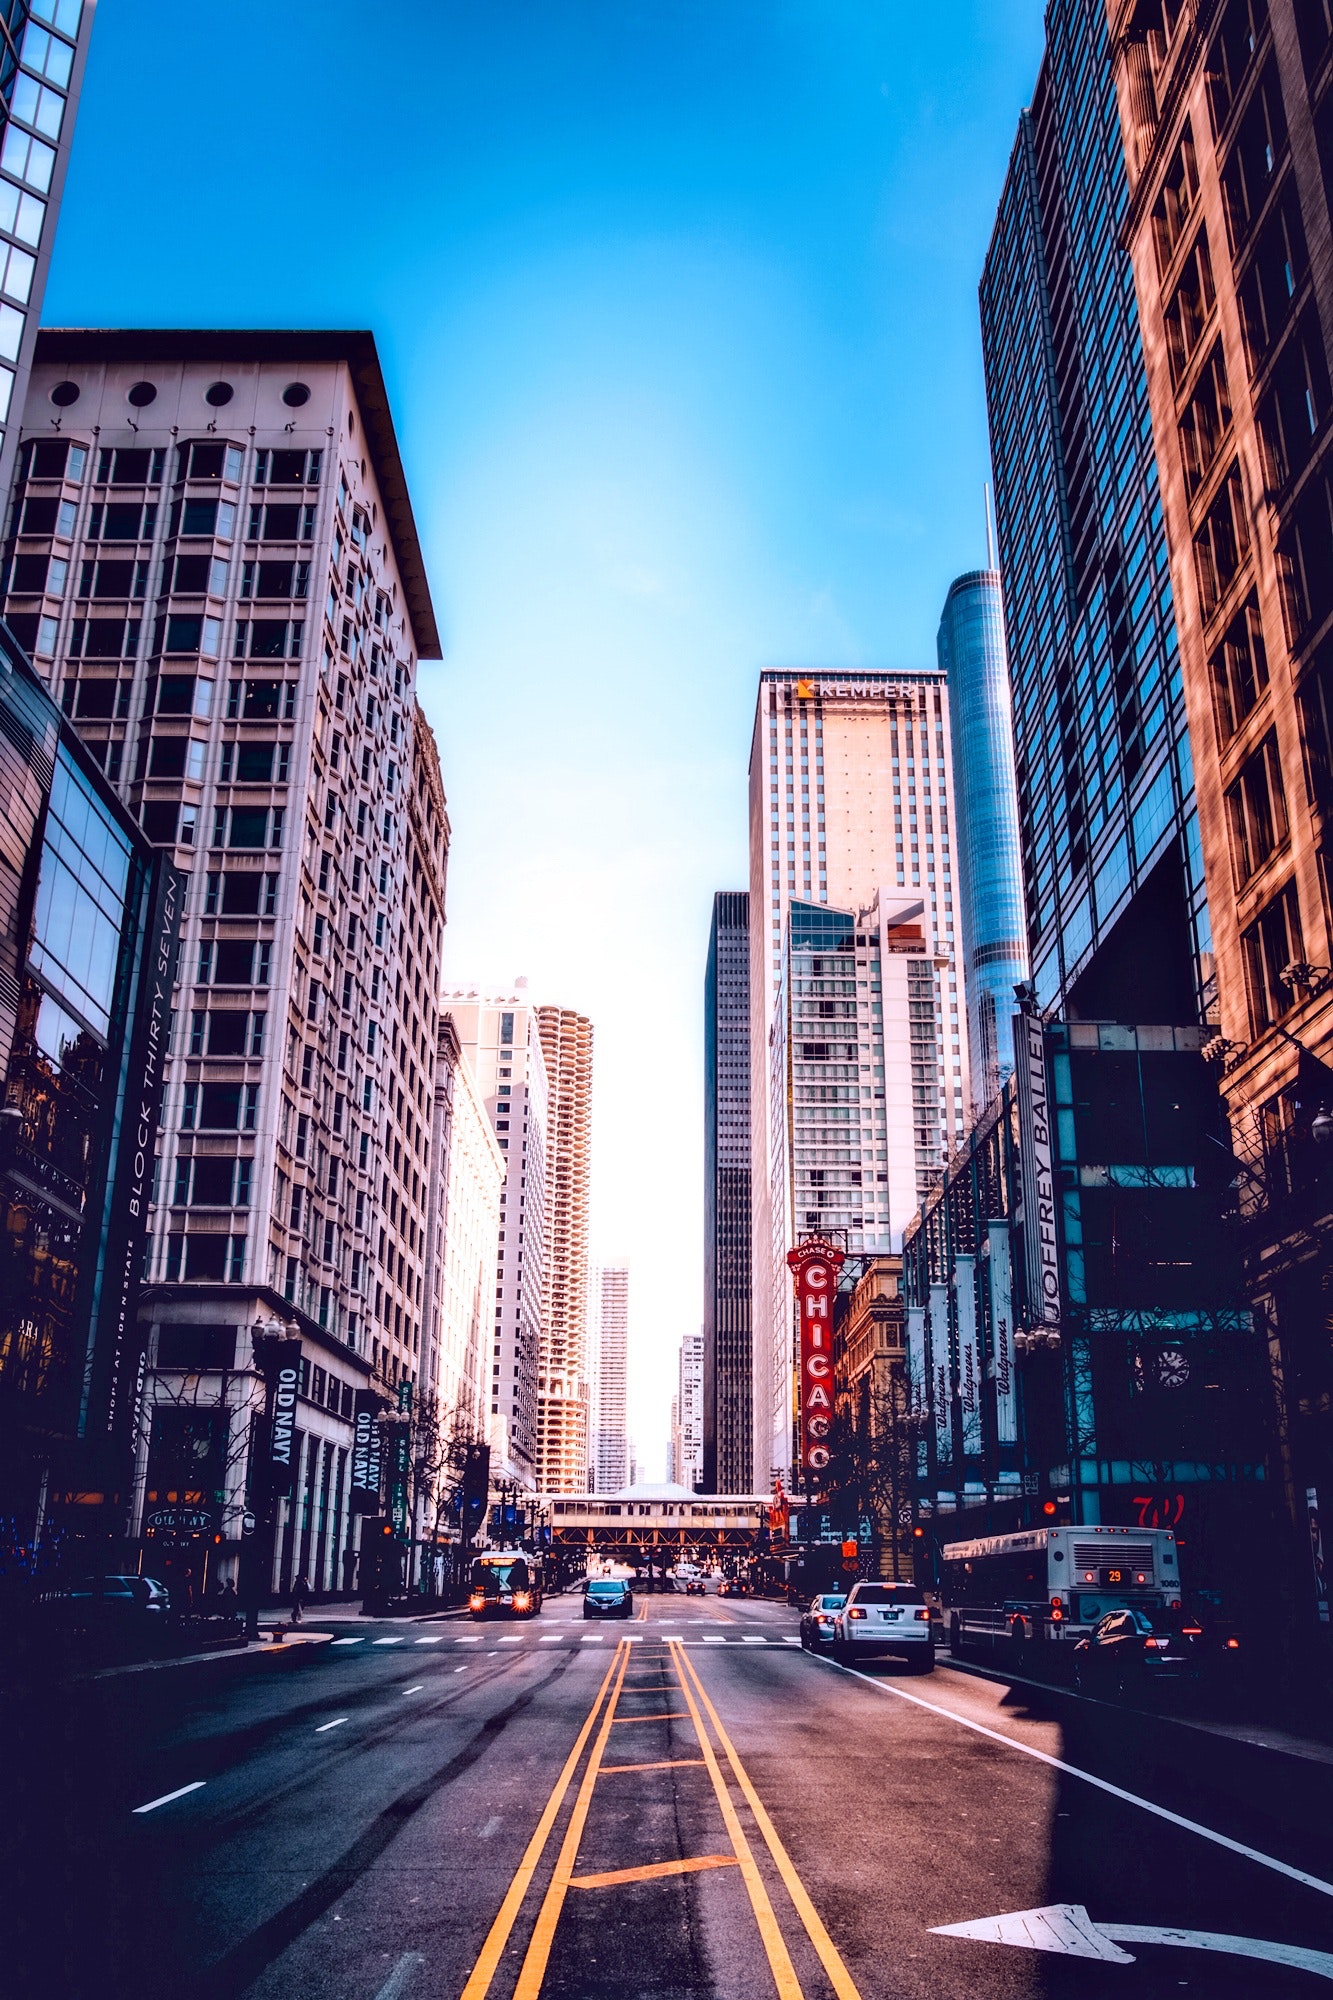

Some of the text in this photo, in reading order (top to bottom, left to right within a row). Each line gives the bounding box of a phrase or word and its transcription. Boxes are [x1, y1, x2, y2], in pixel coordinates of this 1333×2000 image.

[819, 682, 912, 698] KEMPER
[129, 875, 177, 1217] BLOCK THIRTY SEVEN
[1028, 1018, 1060, 1322] JOFFREY BALLET
[797, 1247, 827, 1258] CHASE
[107, 1238, 134, 1432] SHOPS AT 108 N STATE
[136, 1351, 146, 1393] OLD
[805, 1265, 830, 1470] CHICAGO
[997, 1318, 1013, 1396] Walgreens
[272, 1368, 297, 1465] OLD NAVY
[937, 1365, 949, 1429] Walgreens
[963, 1343, 977, 1414] Walgreens
[352, 1412, 371, 1490] OLD NAVY
[1108, 1570, 1122, 1582] 29
